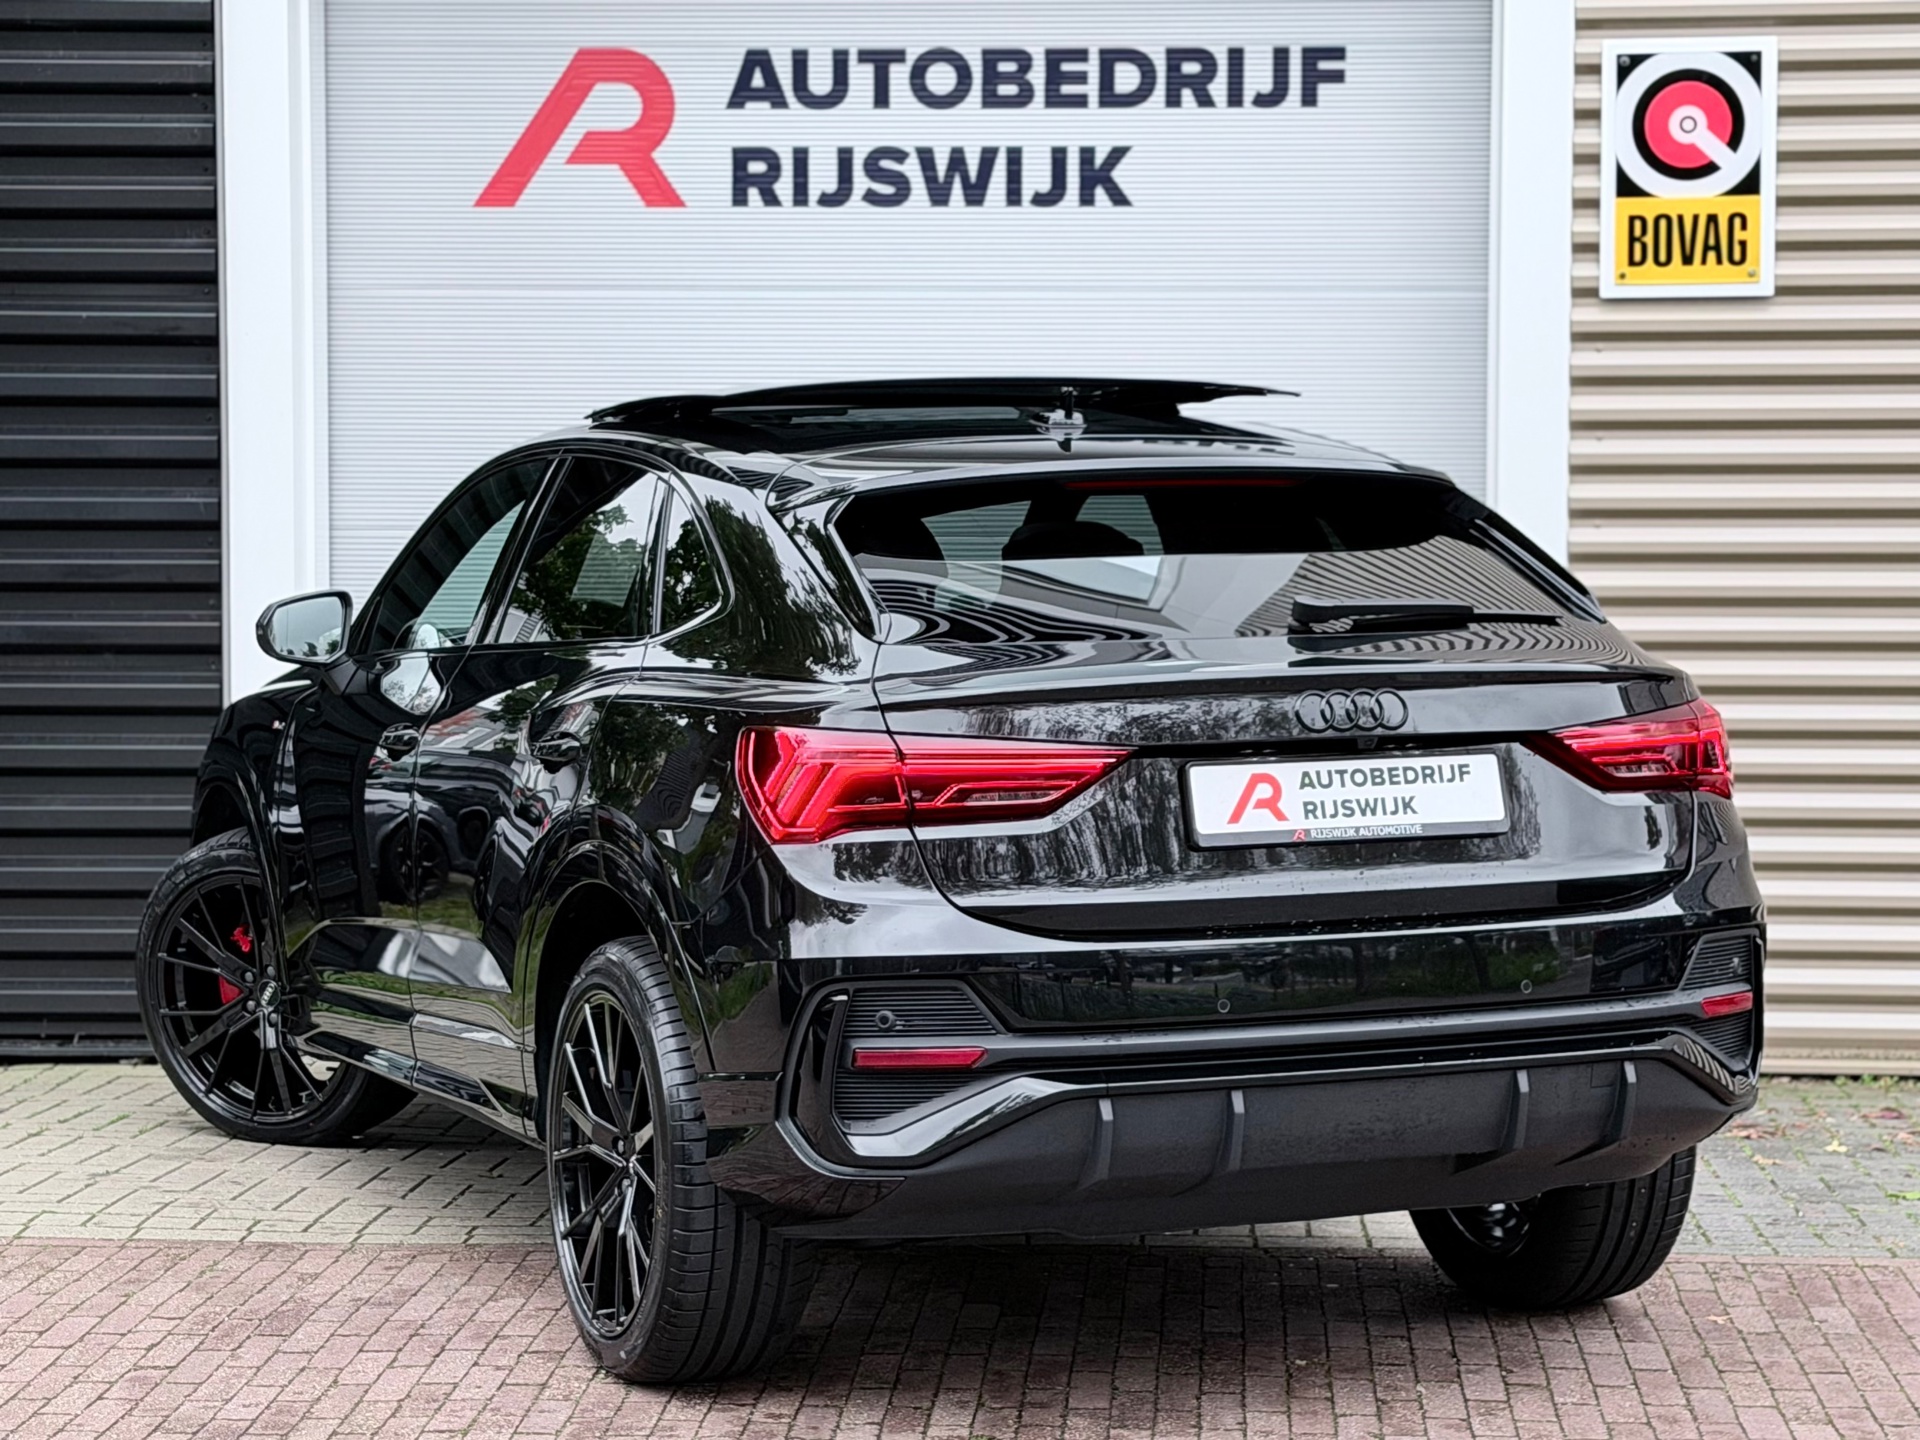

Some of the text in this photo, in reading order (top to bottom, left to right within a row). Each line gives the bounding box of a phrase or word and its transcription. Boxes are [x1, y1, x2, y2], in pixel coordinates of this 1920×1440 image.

[726, 46, 1347, 110] AUTOBEDRIJF
[731, 145, 1133, 207] RIJSWIJK
[1627, 212, 1748, 267] BOVAG
[1299, 763, 1471, 790] AUTOBEDRIJF
[1303, 796, 1419, 820] RIJSWIJK
[1310, 828, 1356, 838] RIJSWIJK
[1359, 824, 1423, 835] AUTOMOTIVE
